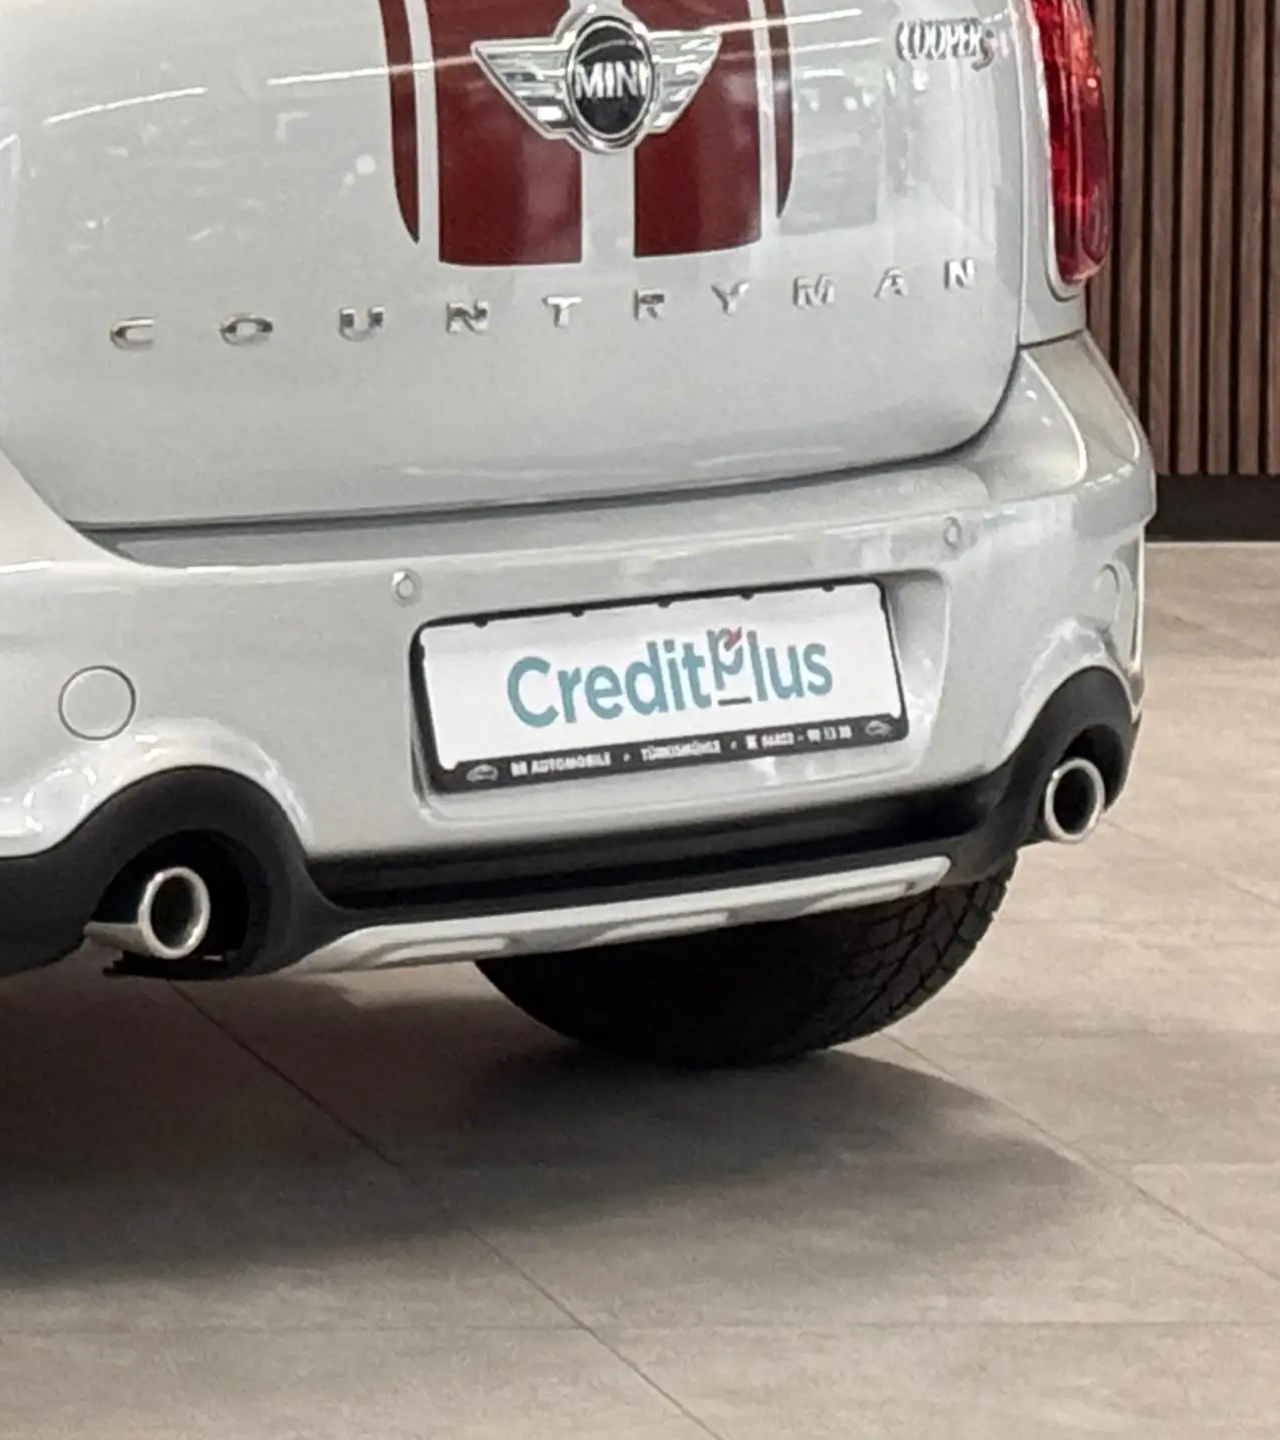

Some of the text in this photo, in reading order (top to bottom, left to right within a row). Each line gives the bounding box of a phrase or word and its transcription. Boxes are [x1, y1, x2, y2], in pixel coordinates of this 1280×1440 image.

[574, 60, 649, 99] MINI
[109, 256, 976, 351] COUNTRYMAN
[506, 626, 834, 729] CreditPlus
